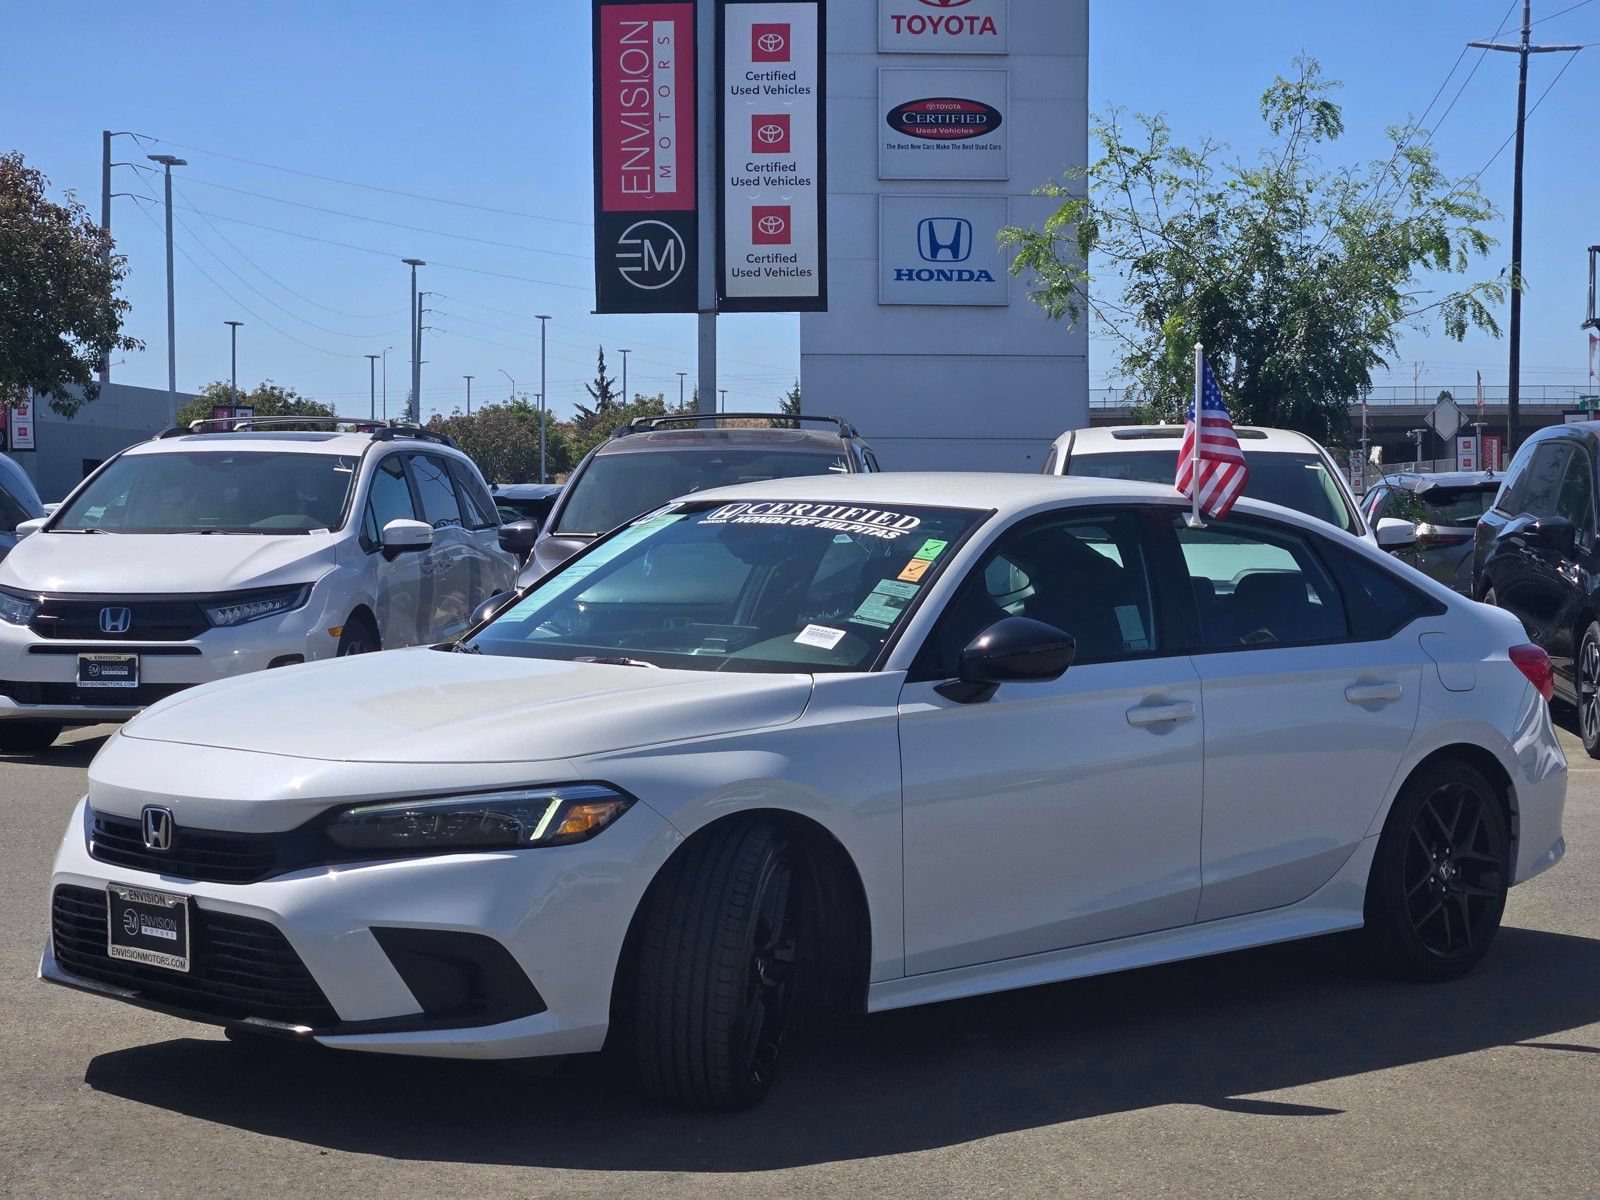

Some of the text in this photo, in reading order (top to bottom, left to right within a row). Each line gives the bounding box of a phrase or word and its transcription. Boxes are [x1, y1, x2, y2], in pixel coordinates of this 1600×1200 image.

[891, 15, 997, 35] TOYOTA
[745, 71, 796, 81] Certified
[731, 85, 811, 96] Used Vehicles
[620, 21, 650, 194] ENVISION
[658, 36, 671, 178] MOTORS
[902, 112, 987, 124] CERTIFIED
[745, 162, 796, 172] Certified
[731, 176, 811, 187] Used Vehicles
[746, 253, 797, 263] Certified
[731, 267, 812, 278] Used Vehicles
[894, 269, 995, 282] HONDA
[746, 502, 921, 530] CERTIFIED
[731, 515, 901, 539] HONDA OF MILPITAS
[128, 890, 166, 905] ENVISION
[140, 913, 177, 931] ENVISION
[143, 928, 174, 939] MOTORS
[111, 946, 186, 970] ENVISIONMOTORS.COM
